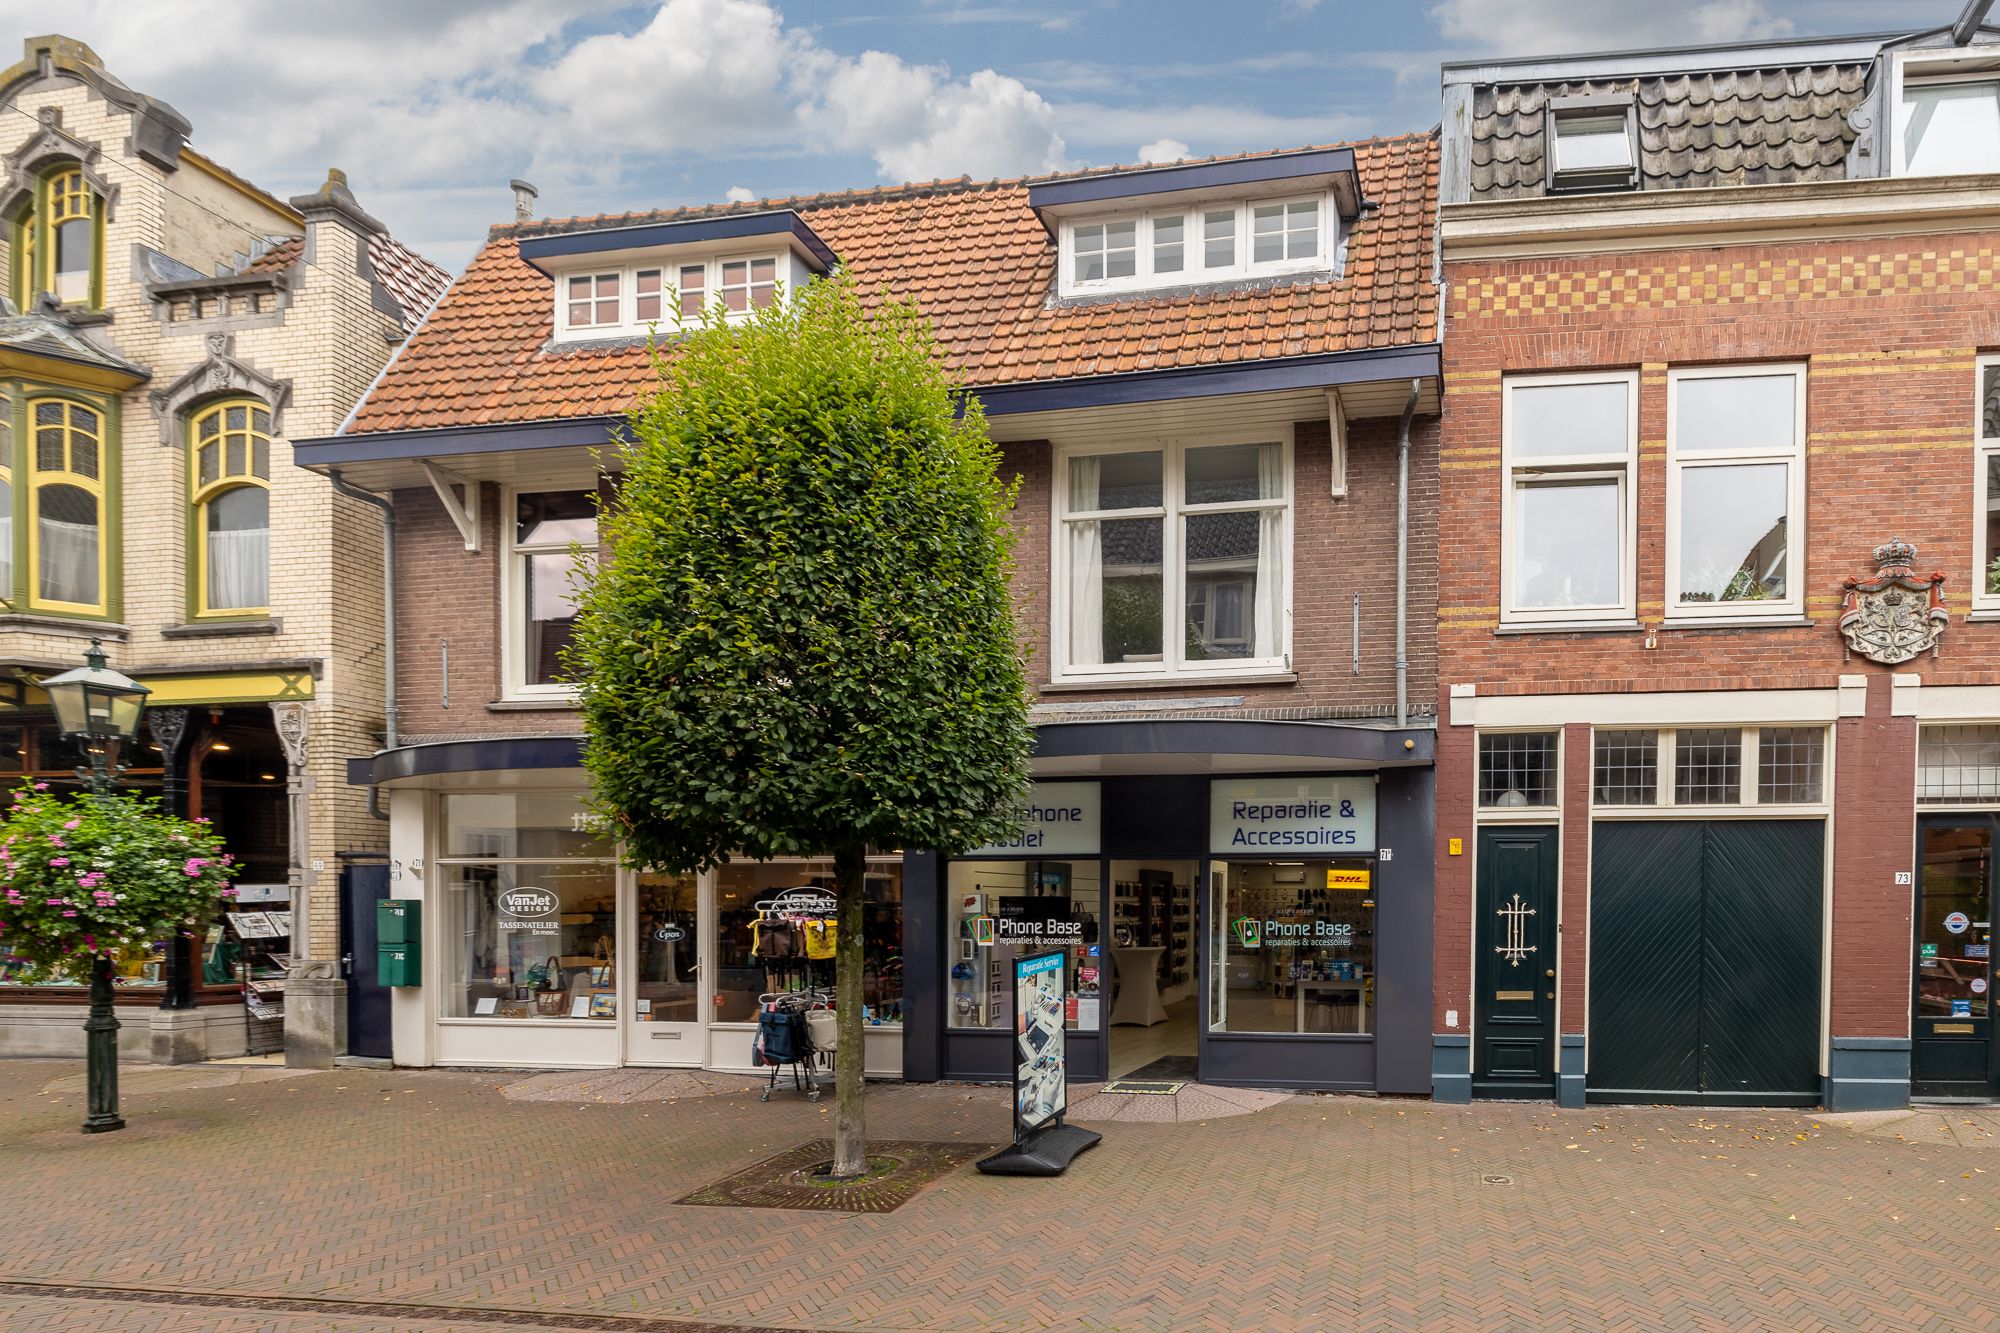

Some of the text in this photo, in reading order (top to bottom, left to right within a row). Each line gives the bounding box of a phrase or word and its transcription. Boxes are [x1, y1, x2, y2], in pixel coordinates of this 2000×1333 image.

[1233, 799, 1356, 823] Reparatie &
[1231, 827, 1356, 846] Accessoires
[1897, 874, 1909, 884] 73
[506, 894, 550, 906] VanJet
[498, 922, 559, 930] TASSENATELIER
[999, 918, 1082, 935] Phone Base
[1265, 920, 1352, 936] Phone Base
[659, 929, 680, 940] Open
[999, 936, 1082, 946] reparaties & accessoires
[1265, 937, 1352, 948] reparaties & accessoires
[1022, 960, 1044, 975] Reparatie
